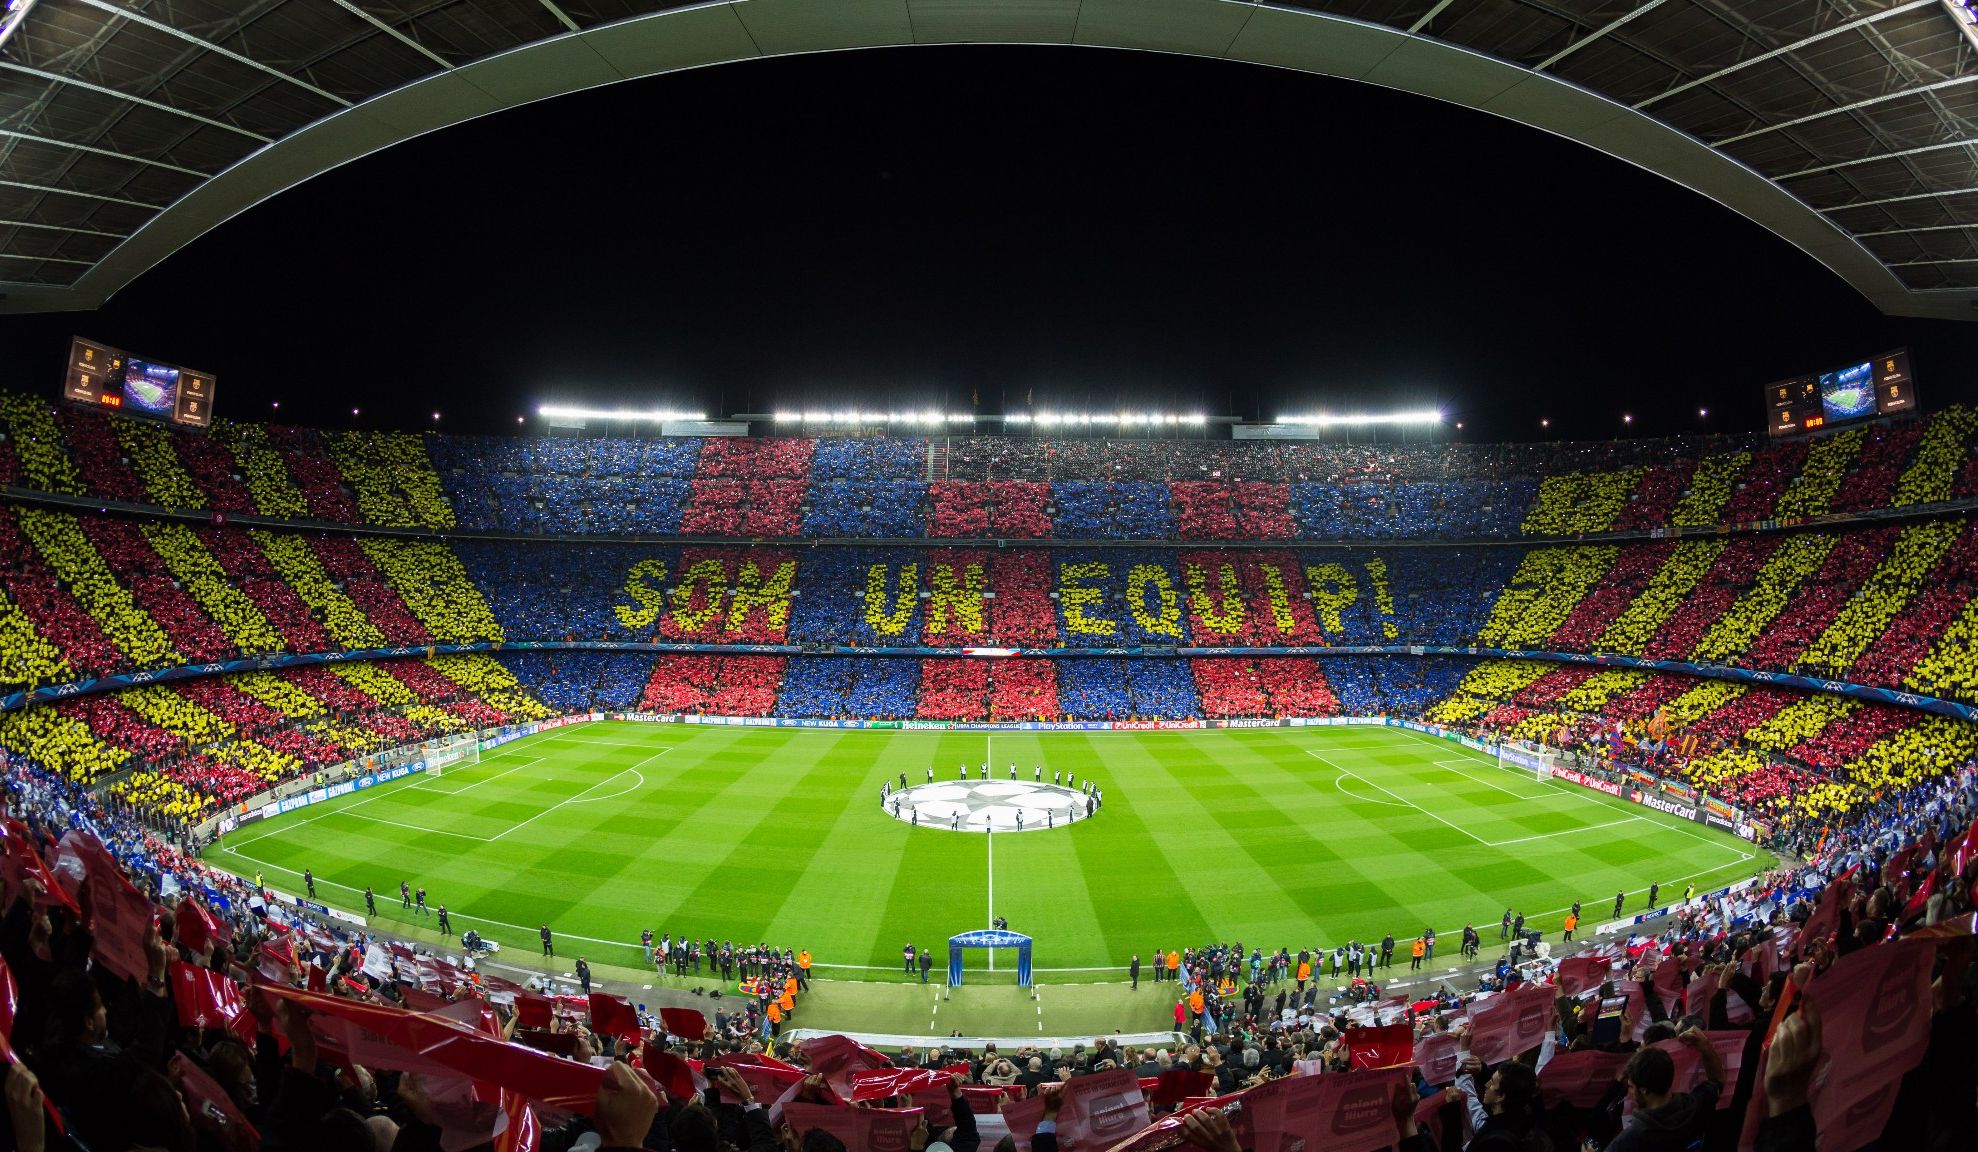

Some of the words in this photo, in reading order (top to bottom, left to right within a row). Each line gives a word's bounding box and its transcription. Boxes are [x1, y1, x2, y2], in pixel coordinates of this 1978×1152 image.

[614, 559, 796, 632] SOM
[863, 562, 990, 636] UN
[1058, 557, 1399, 639] EQUIP!
[626, 713, 675, 723] MasterCard
[902, 720, 946, 730] Heineken
[1038, 722, 1084, 730] PlayStation
[1122, 721, 1155, 729] UniCredit
[1229, 719, 1280, 728] MasterCard
[1590, 778, 1618, 796] UniCredit
[1642, 794, 1697, 820] MasterCard
